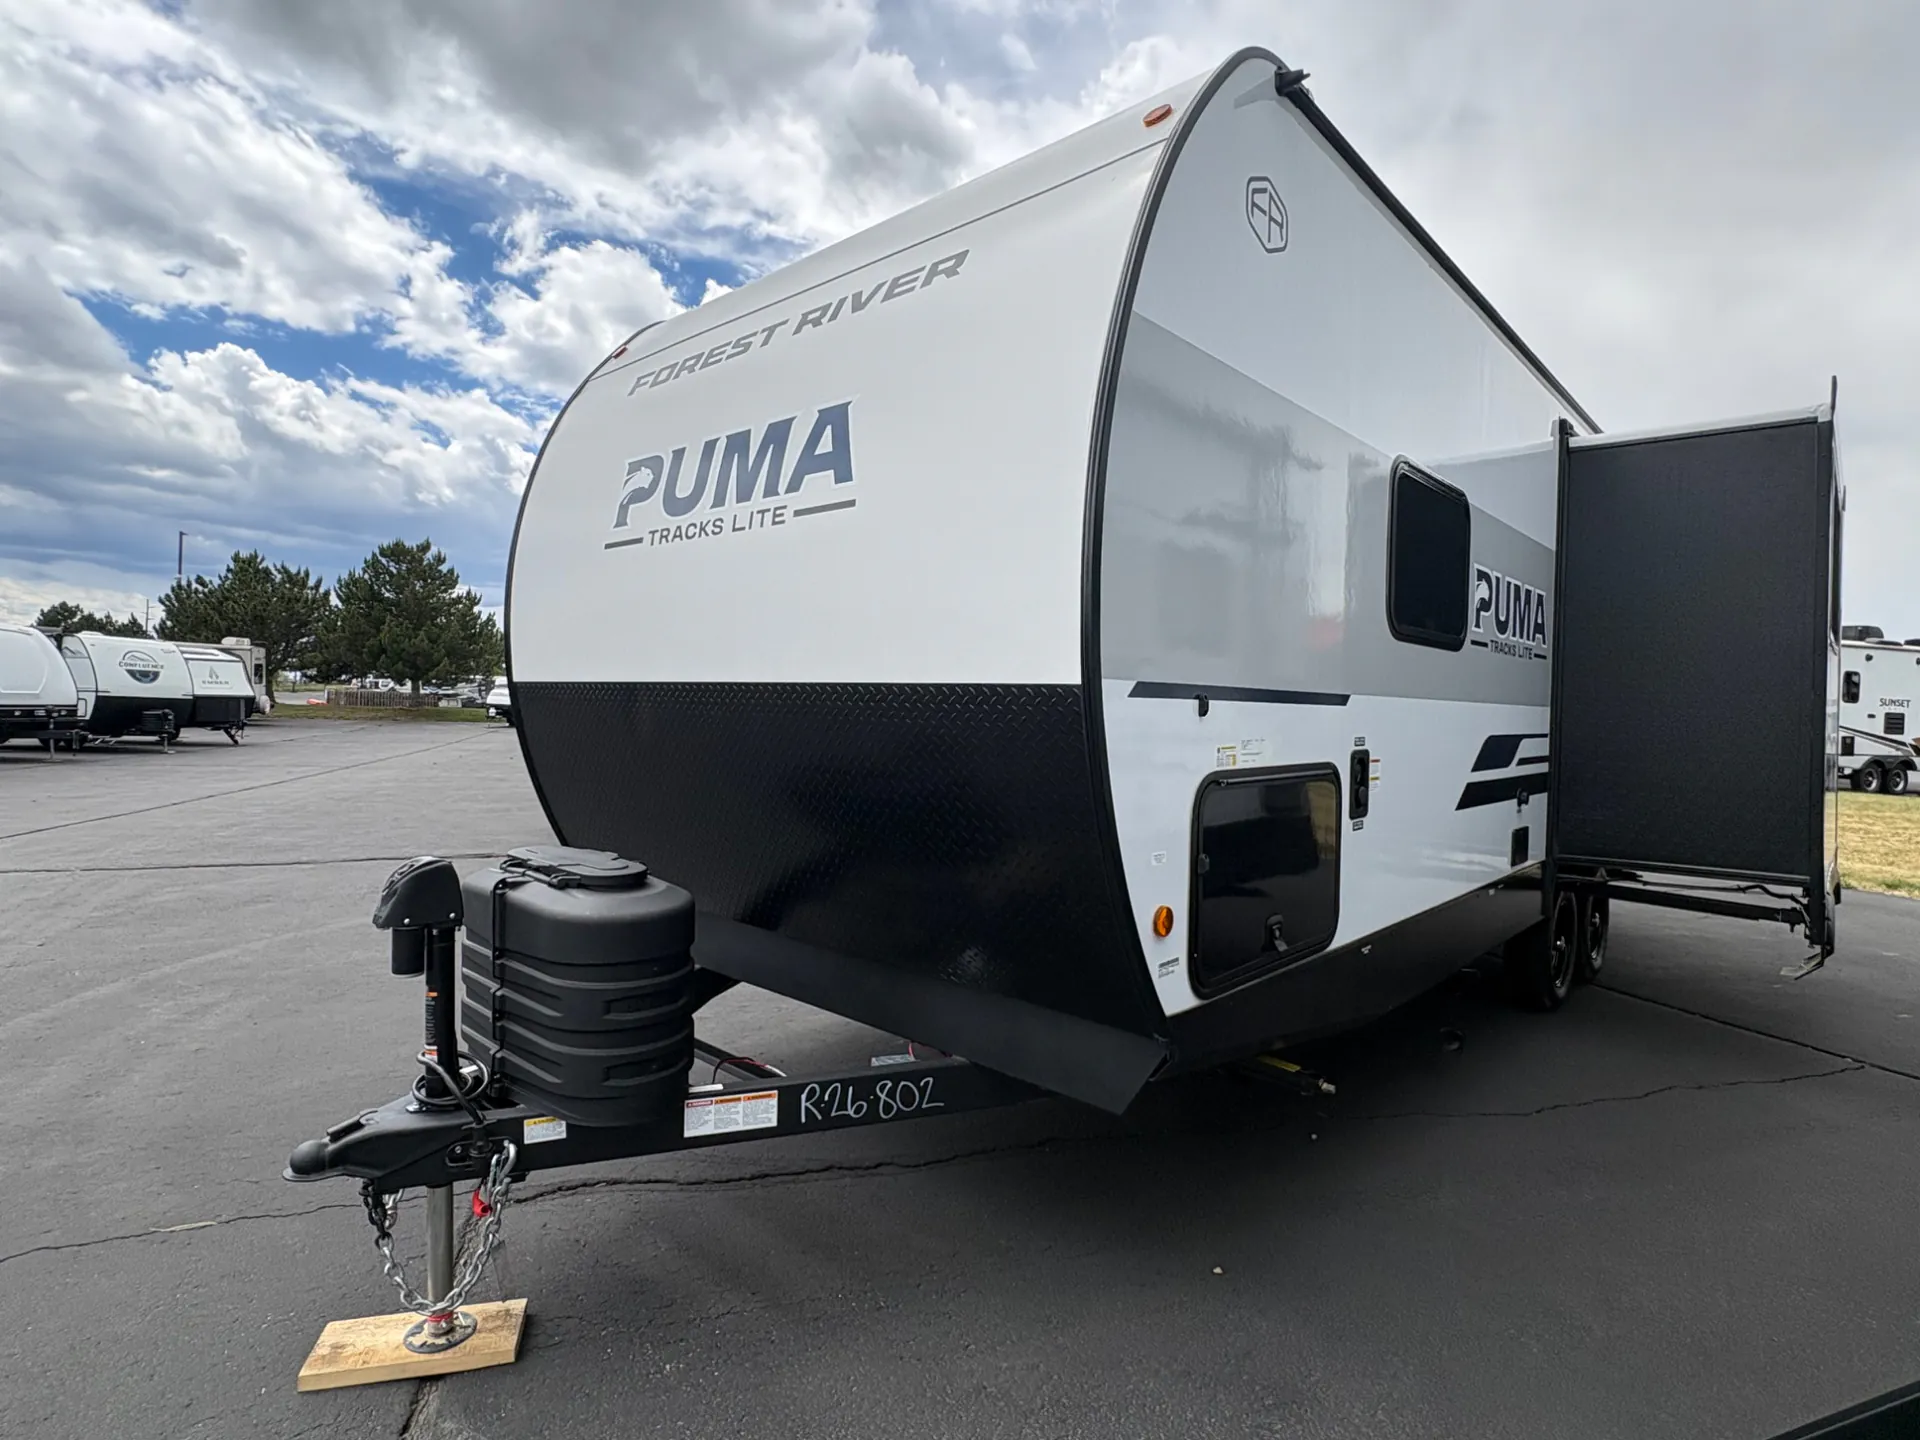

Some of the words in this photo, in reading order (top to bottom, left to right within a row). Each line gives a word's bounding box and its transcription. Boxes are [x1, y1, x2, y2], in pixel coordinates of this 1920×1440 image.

[627, 318, 791, 397] FOREST
[792, 248, 970, 337] RIVER
[613, 399, 854, 529] PUMA
[647, 517, 725, 547] TRACKS
[731, 504, 788, 533] LITE
[1472, 564, 1548, 648] PUMA
[1489, 640, 1517, 657] TRACKS
[1518, 646, 1534, 661] LITE
[1879, 697, 1912, 709] SUNSET
